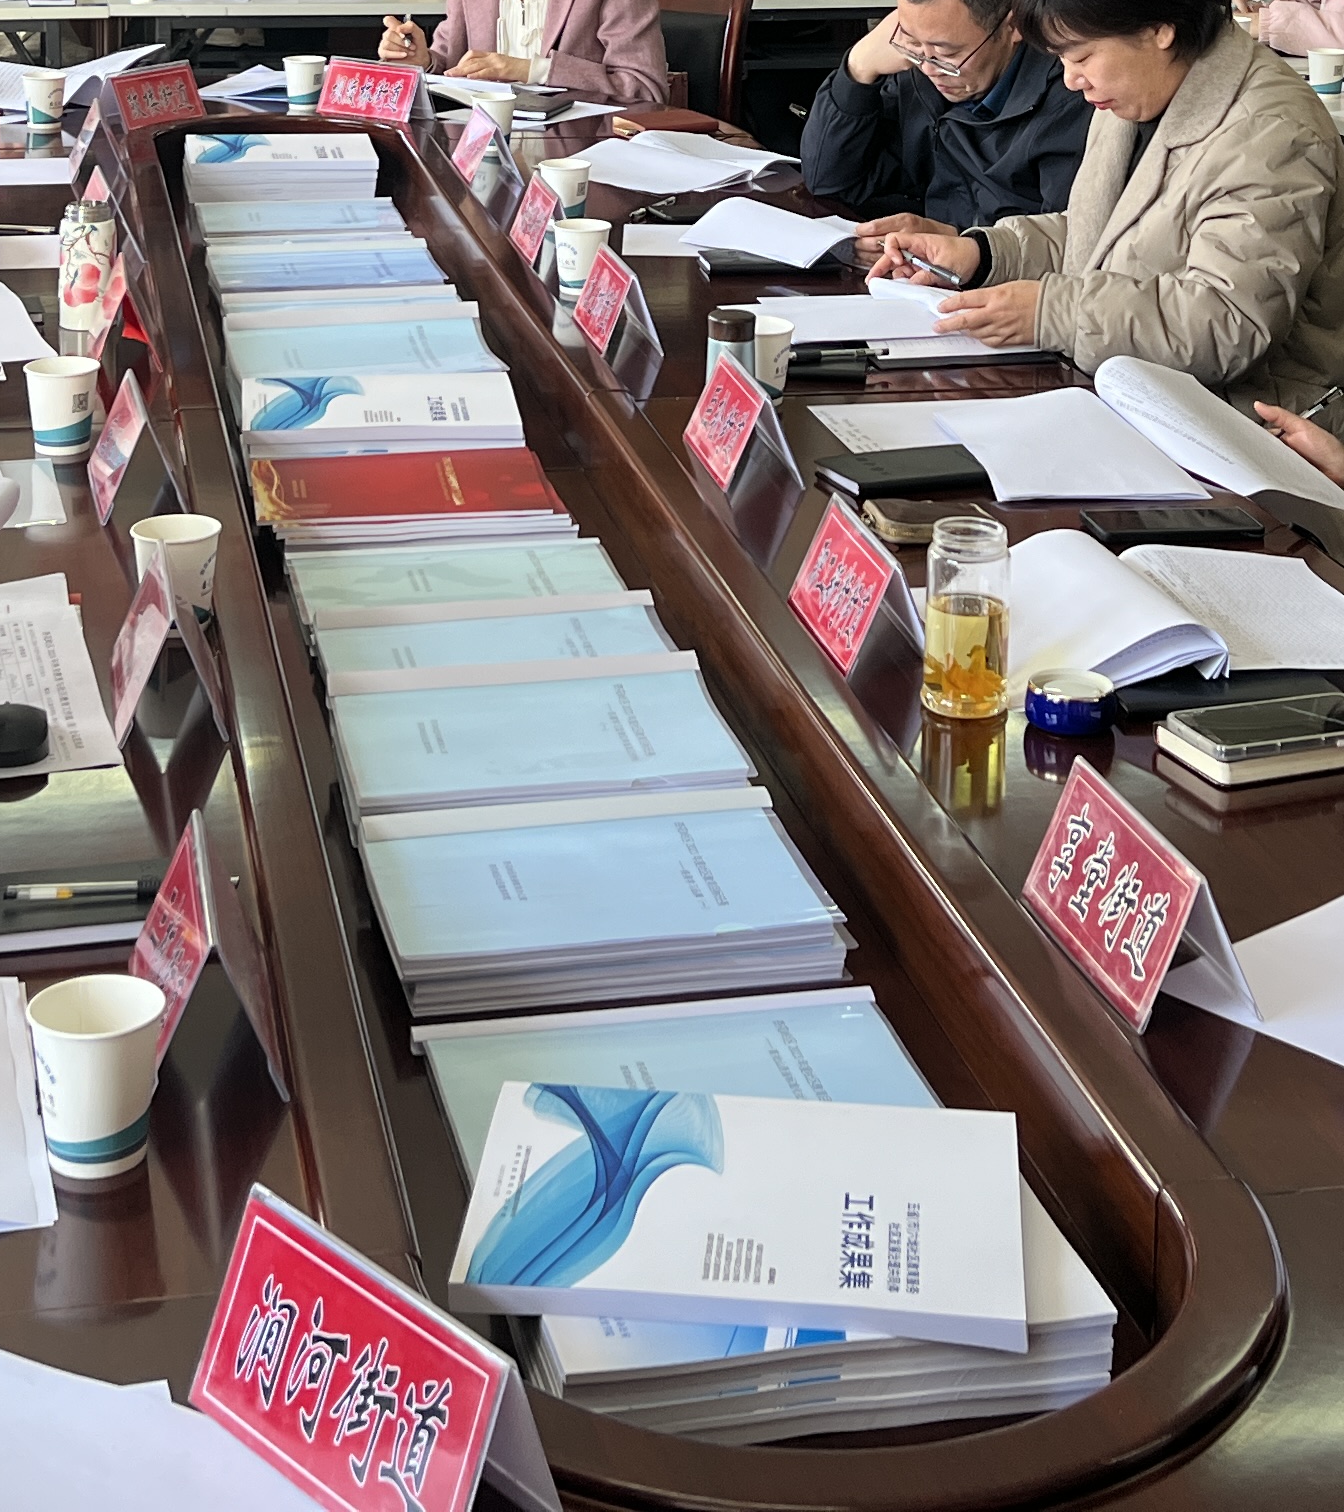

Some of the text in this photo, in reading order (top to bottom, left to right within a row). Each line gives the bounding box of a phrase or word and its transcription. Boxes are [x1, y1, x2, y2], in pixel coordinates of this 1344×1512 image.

[1048, 803, 1171, 983] 享堂街道
[839, 1192, 875, 1290] 工作成果集
[235, 1273, 452, 1512] 涧河街道
